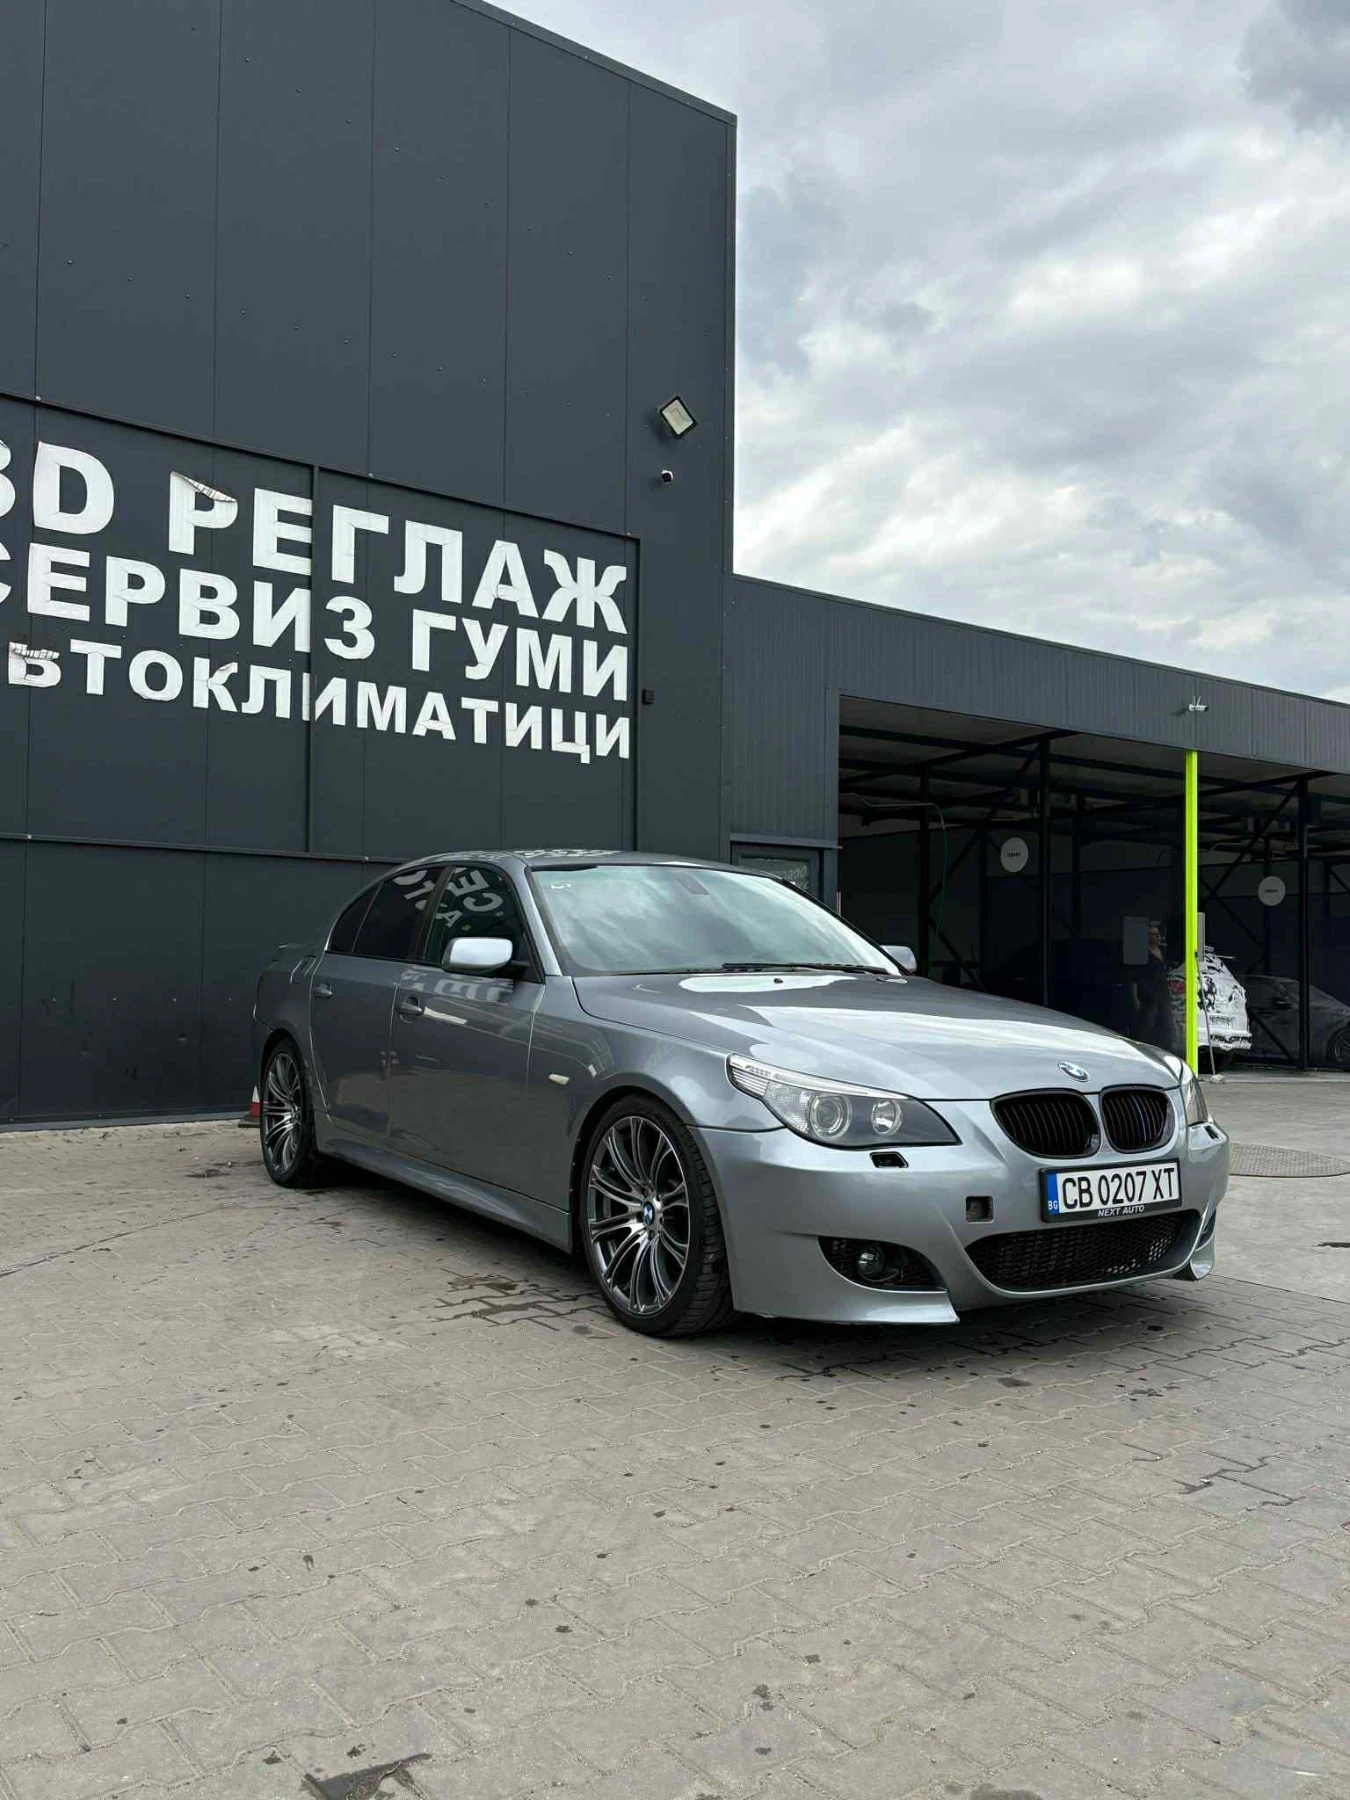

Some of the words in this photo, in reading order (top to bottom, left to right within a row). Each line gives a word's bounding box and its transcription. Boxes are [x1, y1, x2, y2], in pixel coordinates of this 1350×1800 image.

[0, 439, 115, 535] D
[168, 471, 628, 634] РЕГЛАЖ
[0, 541, 375, 660] ЕРВИЗ
[411, 608, 628, 701] ГУМИ
[1048, 1200, 1060, 1211] BG
[1062, 1176, 1093, 1210] CB
[1098, 1170, 1147, 1206] 0207
[1151, 1167, 1175, 1200] XT
[1097, 1206, 1122, 1218] NEXT
[1122, 1204, 1145, 1215] AUTO
